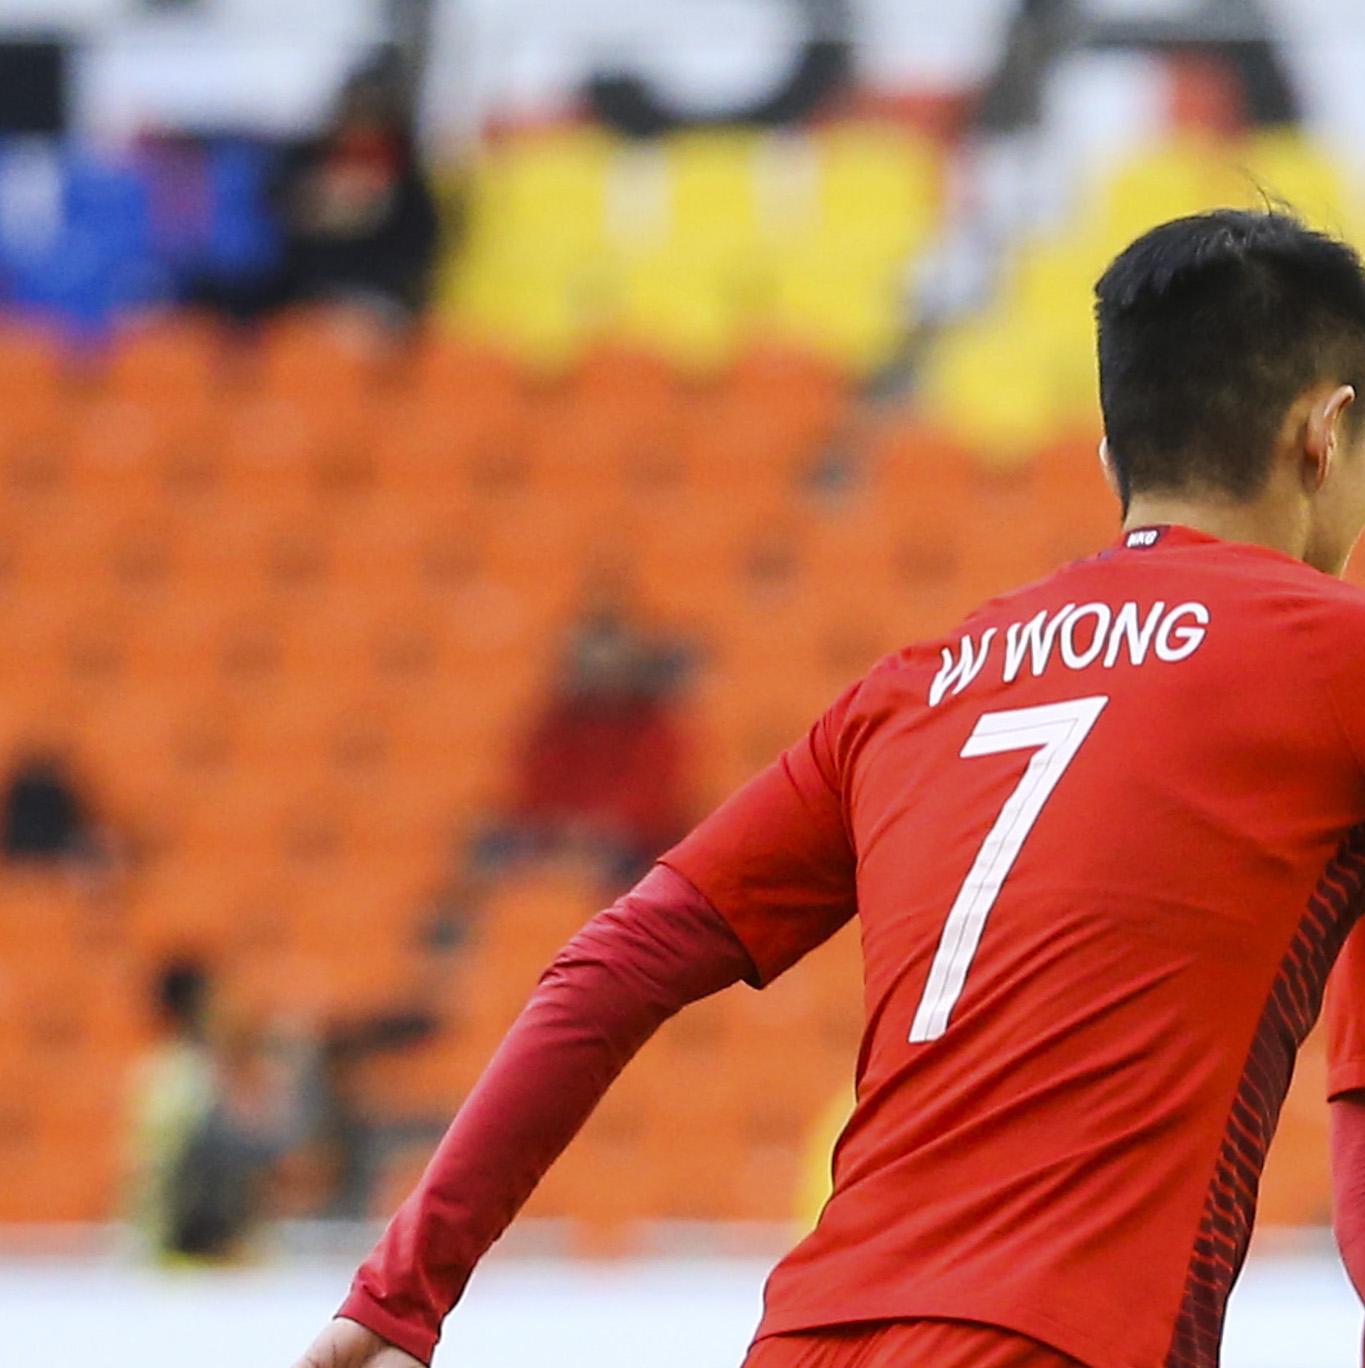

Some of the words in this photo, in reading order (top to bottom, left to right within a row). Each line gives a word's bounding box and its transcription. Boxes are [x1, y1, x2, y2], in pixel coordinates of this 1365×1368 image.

[927, 627, 997, 707] W
[1002, 600, 1211, 684] WONG
[906, 694, 1110, 1044] 7
